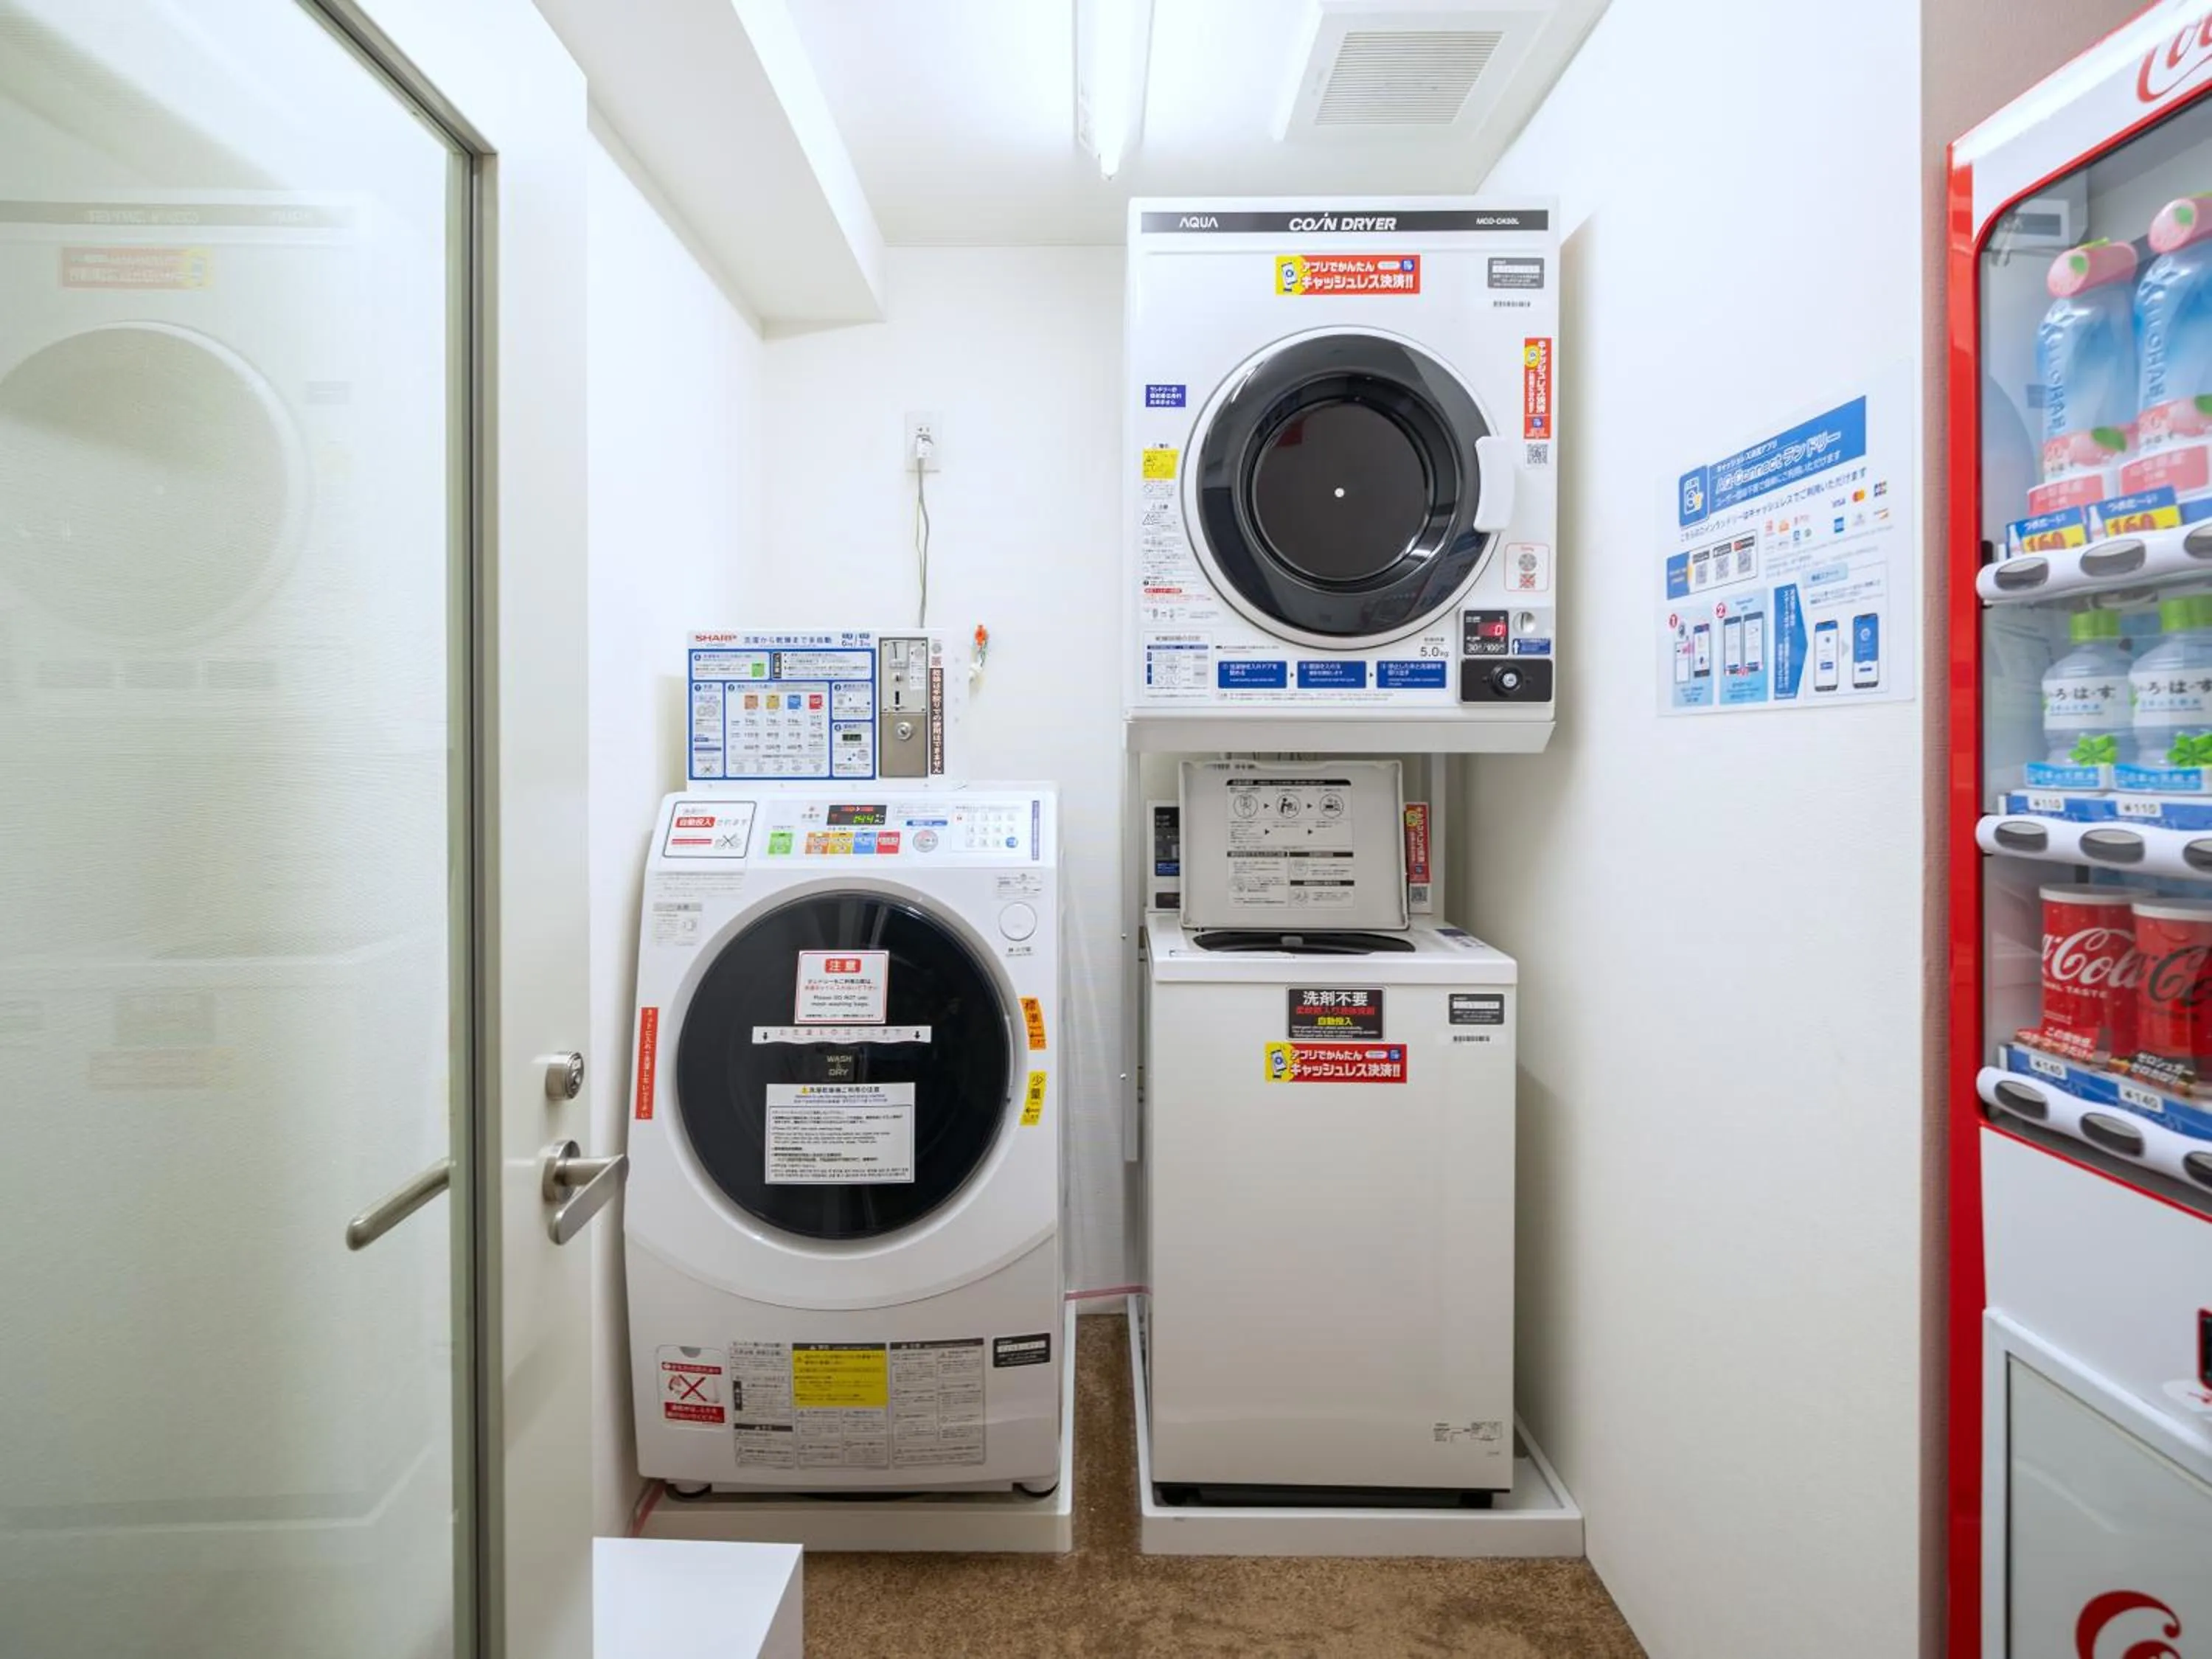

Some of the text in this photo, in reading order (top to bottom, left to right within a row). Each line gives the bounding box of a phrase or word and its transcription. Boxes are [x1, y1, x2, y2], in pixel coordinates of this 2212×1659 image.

[1180, 217, 1218, 228] AQUA
[1290, 212, 1397, 231] COIN DRYER
[1301, 261, 1374, 273] アプリでかんたん
[1301, 275, 1413, 290] キャッシュレス決済!!
[2110, 513, 2157, 535] 160
[2026, 532, 2065, 552] 160
[695, 634, 733, 643] SHARP
[679, 818, 712, 826] 自動投入
[830, 960, 857, 971] 注意
[1303, 991, 1368, 1006] 洗剤不要
[1318, 1018, 1353, 1026] 自動投入
[1291, 1050, 1363, 1060] アプリでかんたん
[1291, 1062, 1402, 1077] キャッシュレス決済!!
